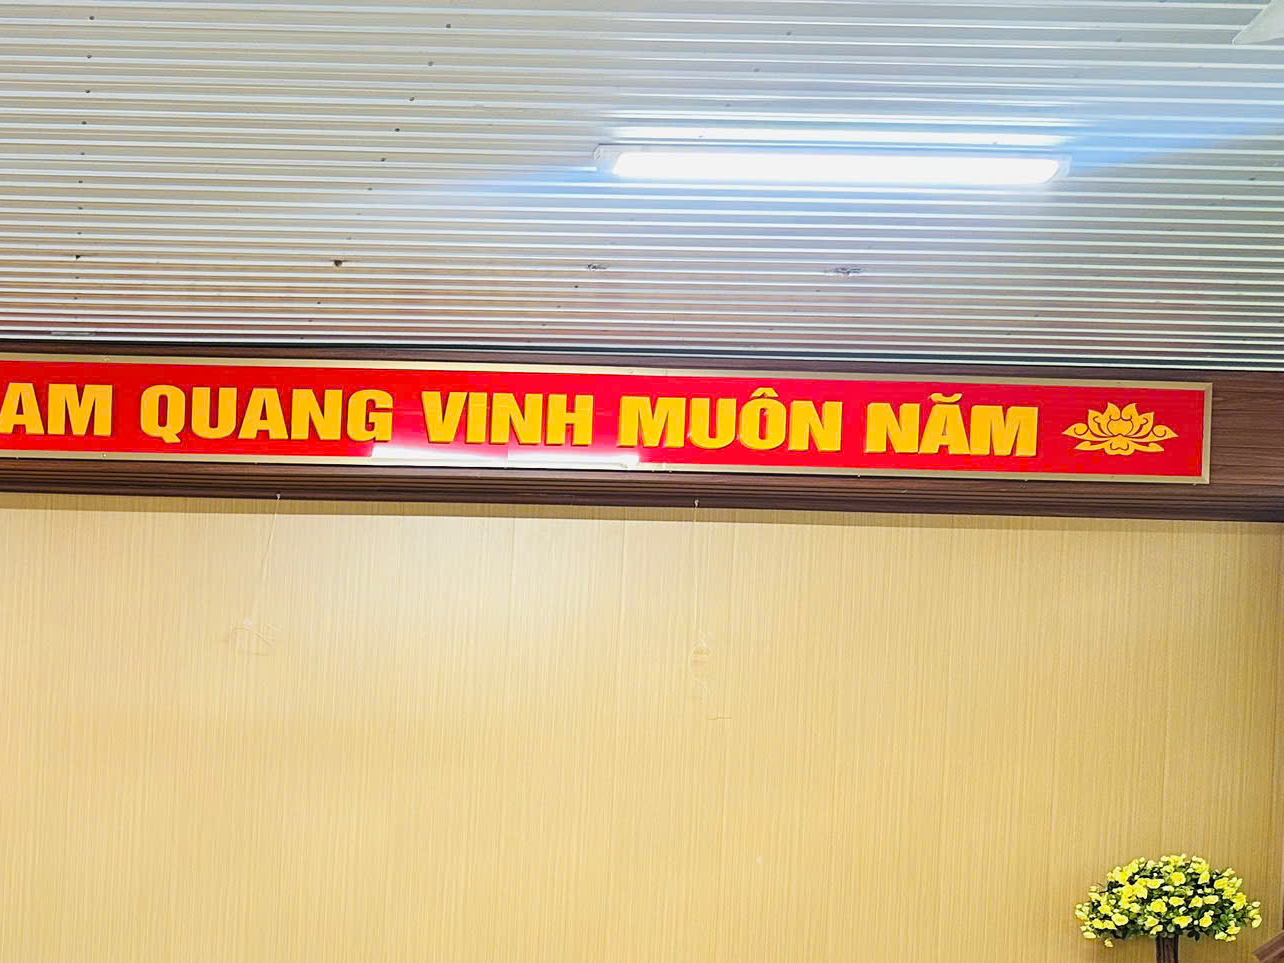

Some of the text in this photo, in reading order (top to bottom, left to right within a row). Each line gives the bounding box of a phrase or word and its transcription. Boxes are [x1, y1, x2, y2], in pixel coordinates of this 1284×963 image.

[141, 386, 392, 442] QUANG
[423, 392, 593, 445] VINH
[620, 388, 842, 451] MUÔN
[867, 394, 1038, 456] NĂM
